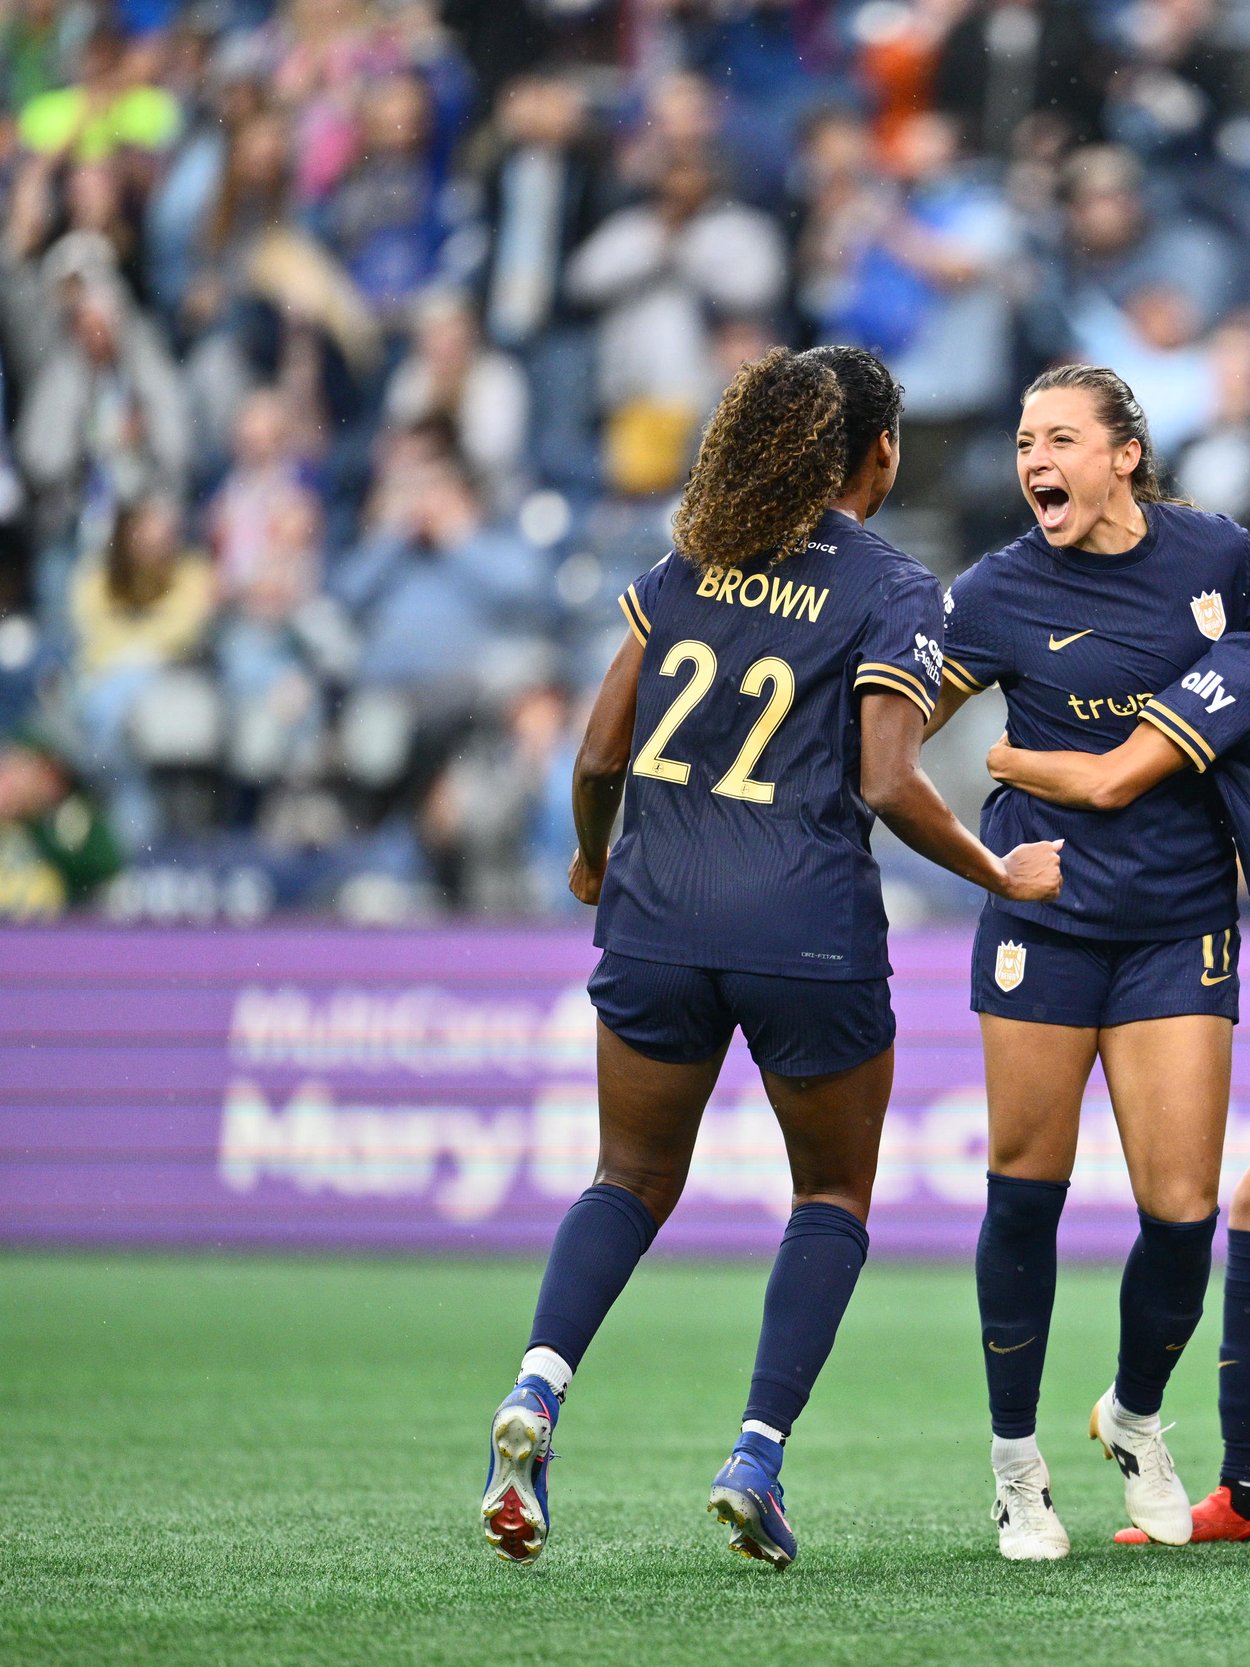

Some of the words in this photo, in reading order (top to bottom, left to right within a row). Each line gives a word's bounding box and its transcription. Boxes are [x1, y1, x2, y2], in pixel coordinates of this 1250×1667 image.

[806, 541, 838, 555] OICE
[696, 565, 829, 623] BROWN
[1181, 670, 1236, 714] ally
[633, 639, 795, 804] 22
